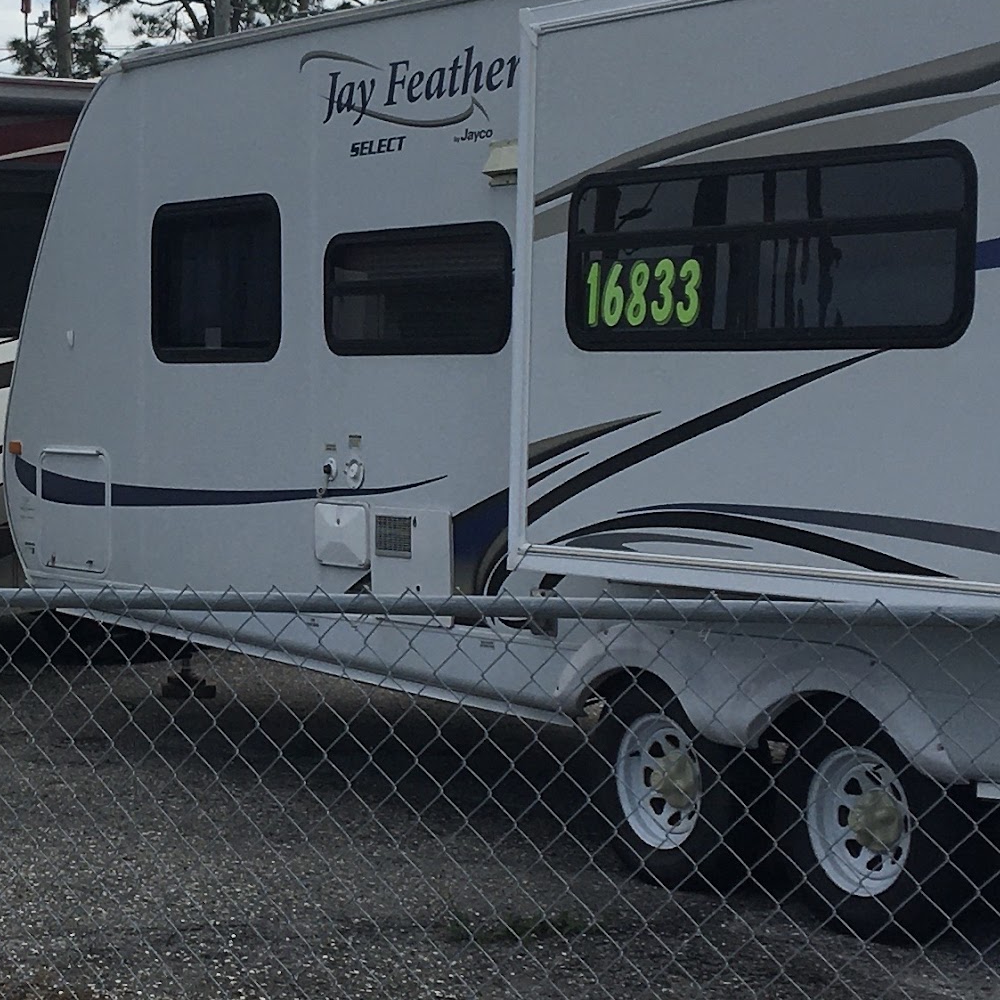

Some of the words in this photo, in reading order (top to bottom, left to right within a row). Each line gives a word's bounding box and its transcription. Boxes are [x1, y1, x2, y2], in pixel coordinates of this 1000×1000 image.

[322, 71, 376, 126] Jay
[384, 45, 520, 107] Feather
[350, 136, 407, 157] SELECT
[460, 128, 494, 143] Jayco
[587, 258, 702, 328] 16833
